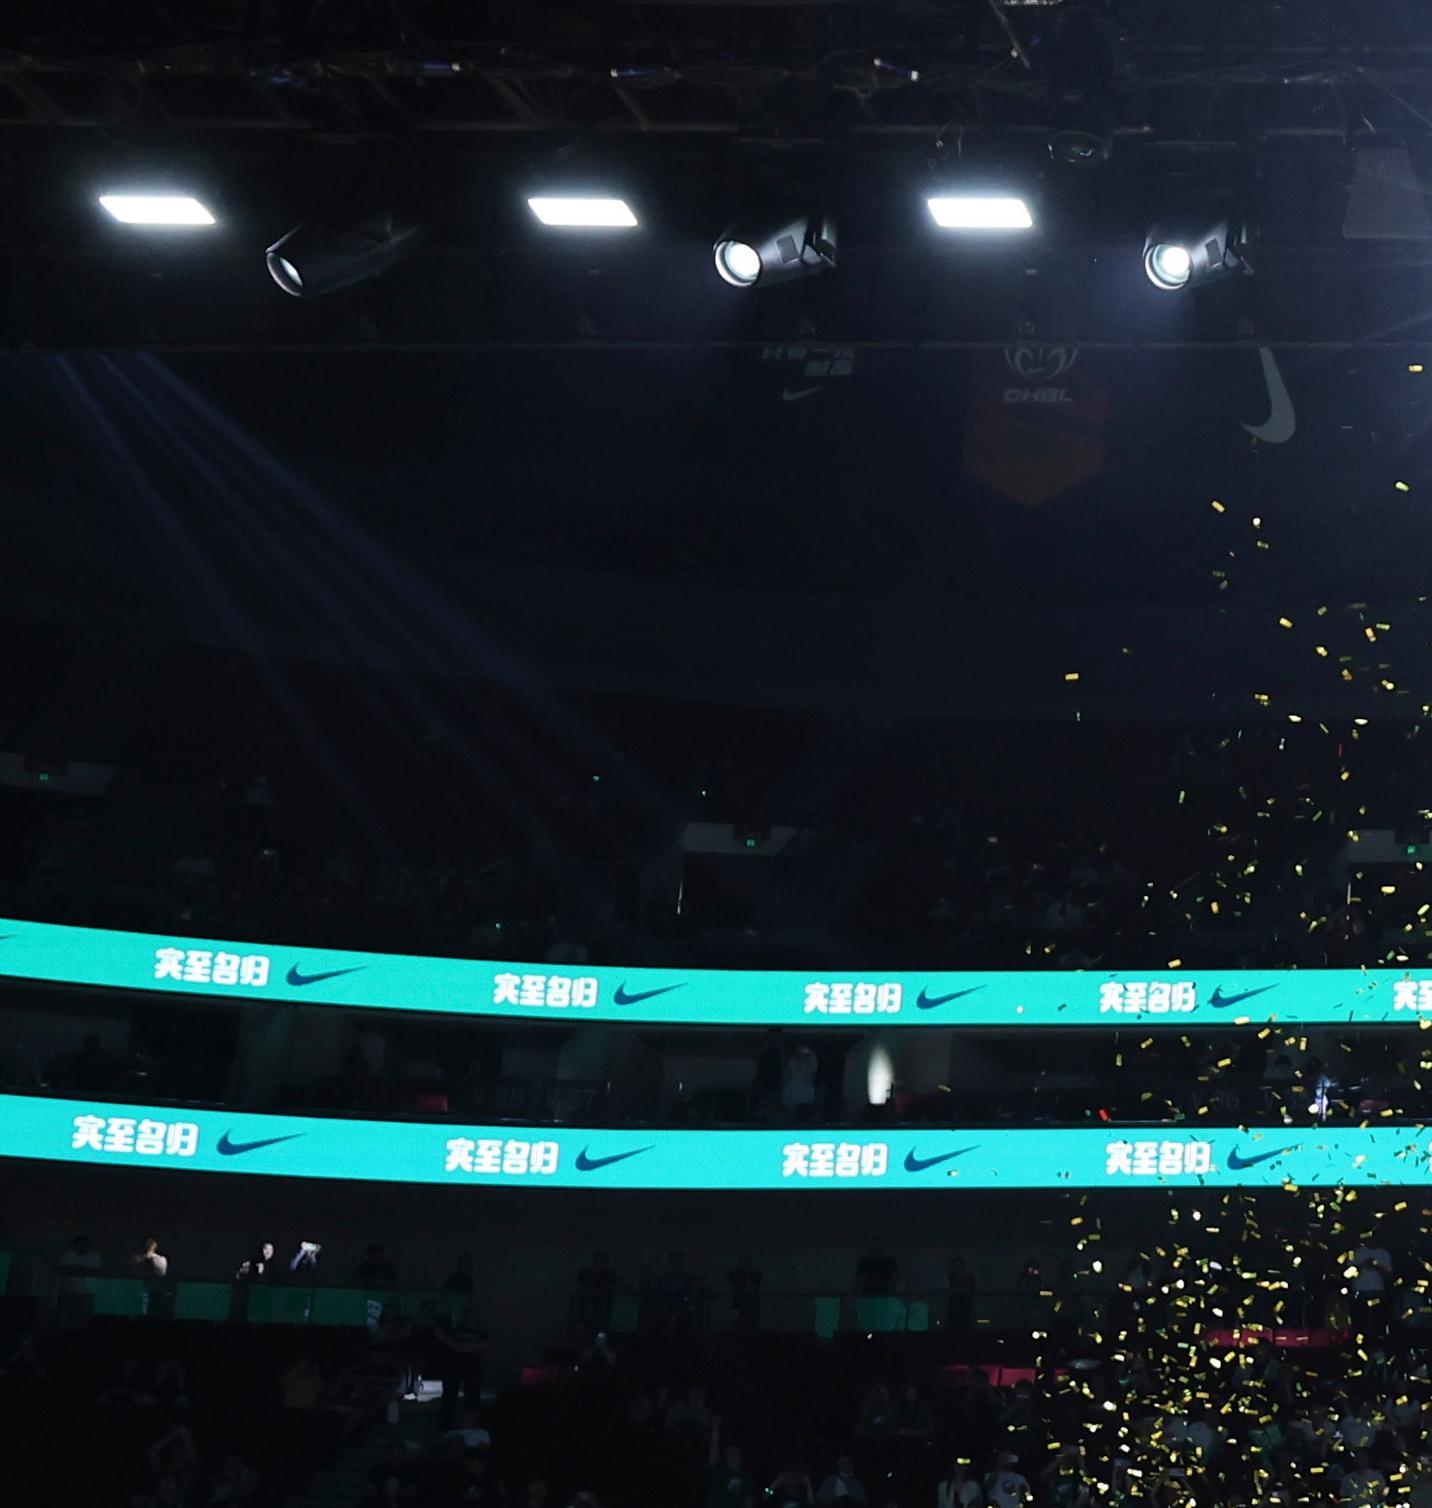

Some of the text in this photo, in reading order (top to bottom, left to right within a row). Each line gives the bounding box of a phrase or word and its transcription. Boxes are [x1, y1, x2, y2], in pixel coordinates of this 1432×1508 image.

[155, 948, 269, 986] 实至名归
[494, 974, 597, 1007] 实至名归
[805, 983, 902, 1013] 实至名归
[1100, 982, 1195, 1012] 实至名归
[73, 1115, 198, 1155] 实至名归
[446, 1138, 559, 1174] 实至名归
[783, 1143, 888, 1176] 实至名归
[1107, 1142, 1211, 1174] 实至名归
